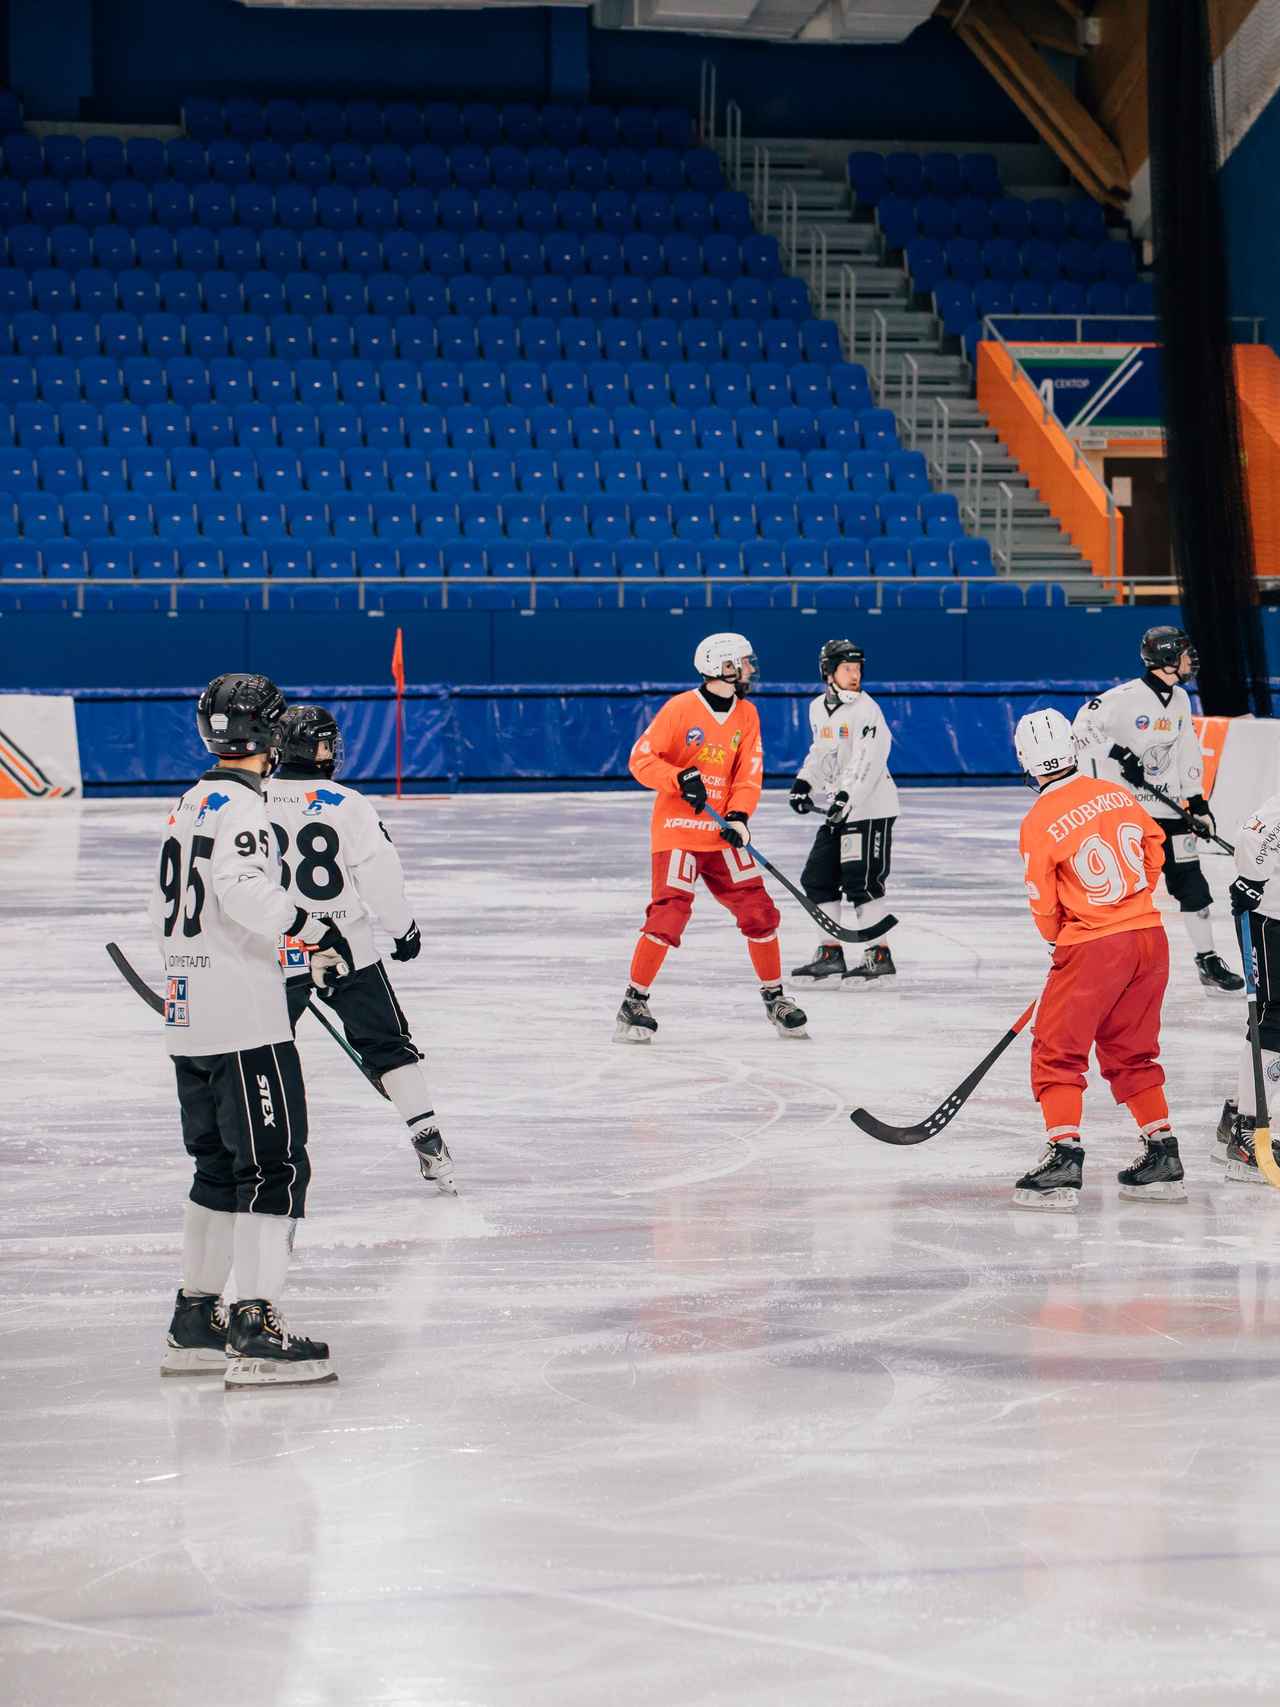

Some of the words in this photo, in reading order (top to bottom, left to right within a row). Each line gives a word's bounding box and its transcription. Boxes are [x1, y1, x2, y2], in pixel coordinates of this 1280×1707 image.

[1054, 378, 1090, 388] СЕКТОР
[1043, 757, 1060, 771] 99
[273, 796, 300, 804] РУСАЛ
[1047, 791, 1134, 843] ЕЛОВИКОВ
[234, 829, 269, 858] 95
[1070, 822, 1149, 906] 99
[159, 835, 215, 937] 95
[256, 1074, 276, 1128] STEX
